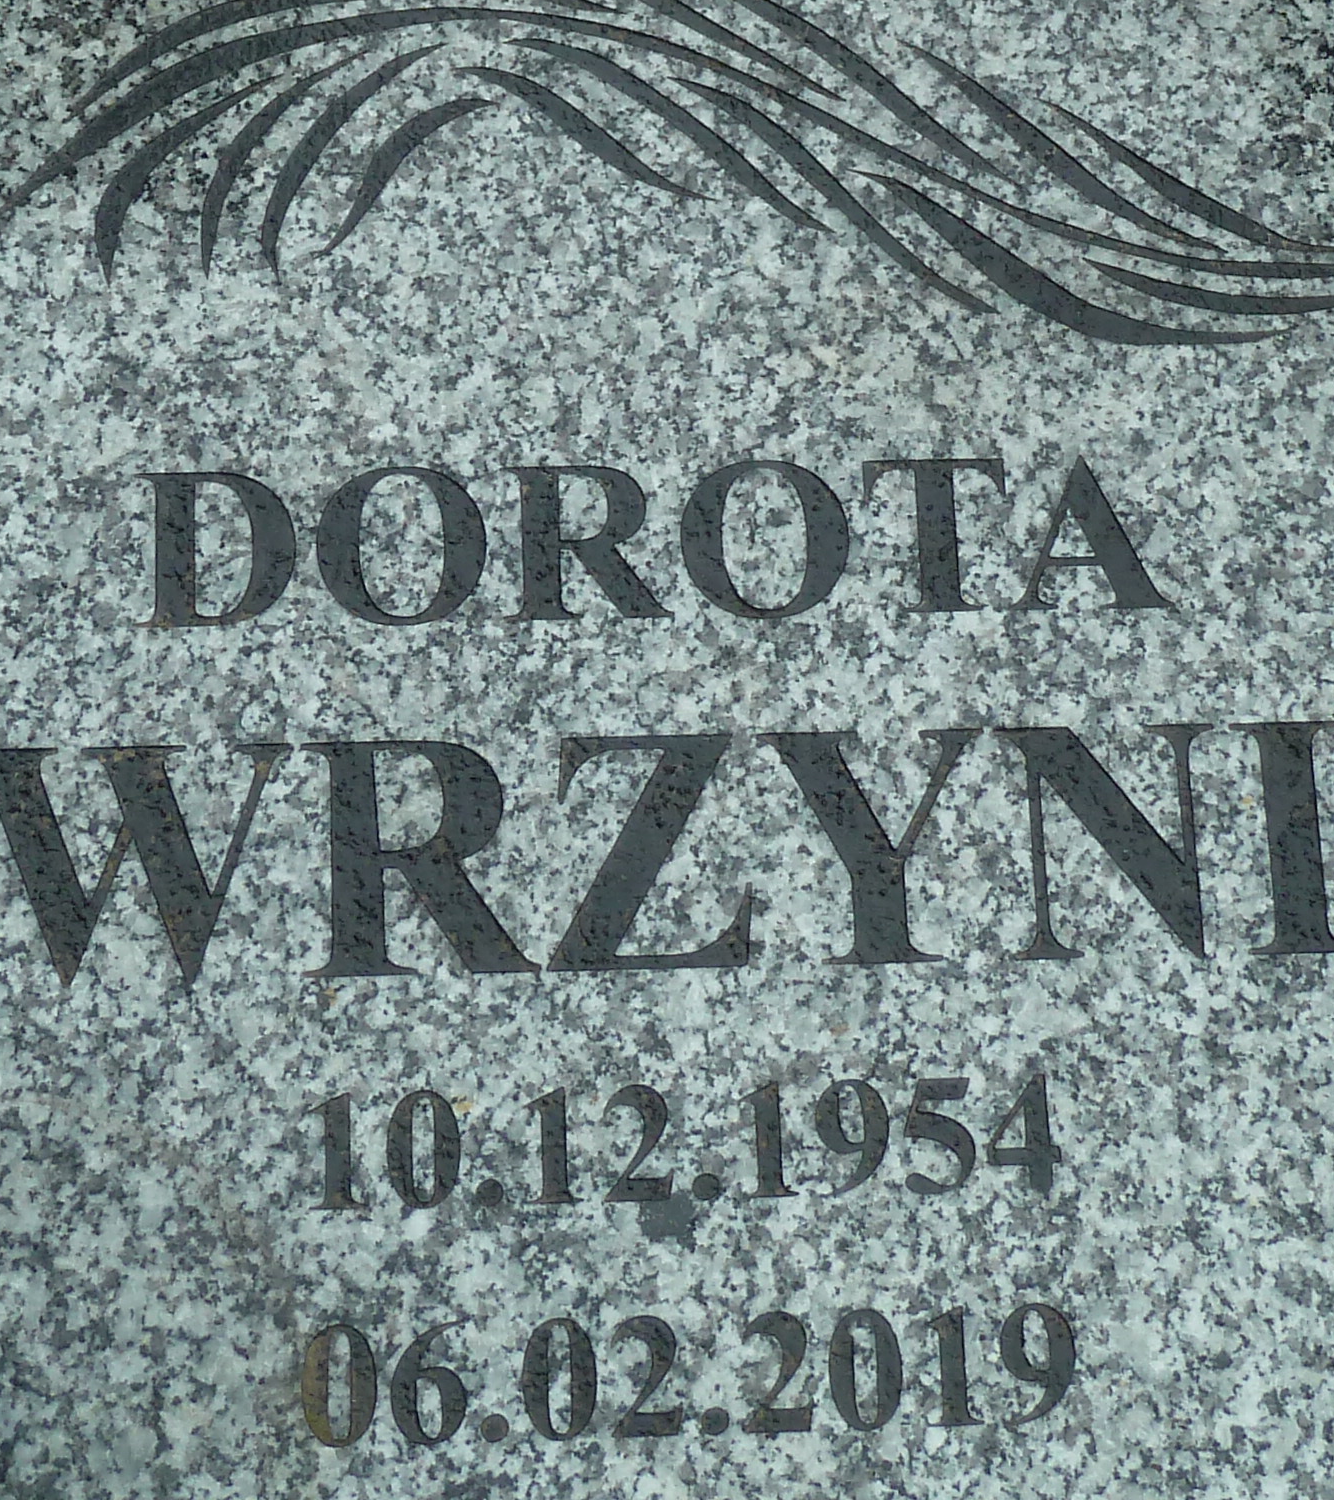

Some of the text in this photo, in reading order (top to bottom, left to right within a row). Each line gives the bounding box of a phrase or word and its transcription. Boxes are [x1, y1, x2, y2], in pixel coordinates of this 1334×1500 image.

[144, 460, 1173, 627] DOROTA
[309, 1074, 1063, 1212] 10.12.1954
[301, 1302, 1077, 1448] 06.02.2019
